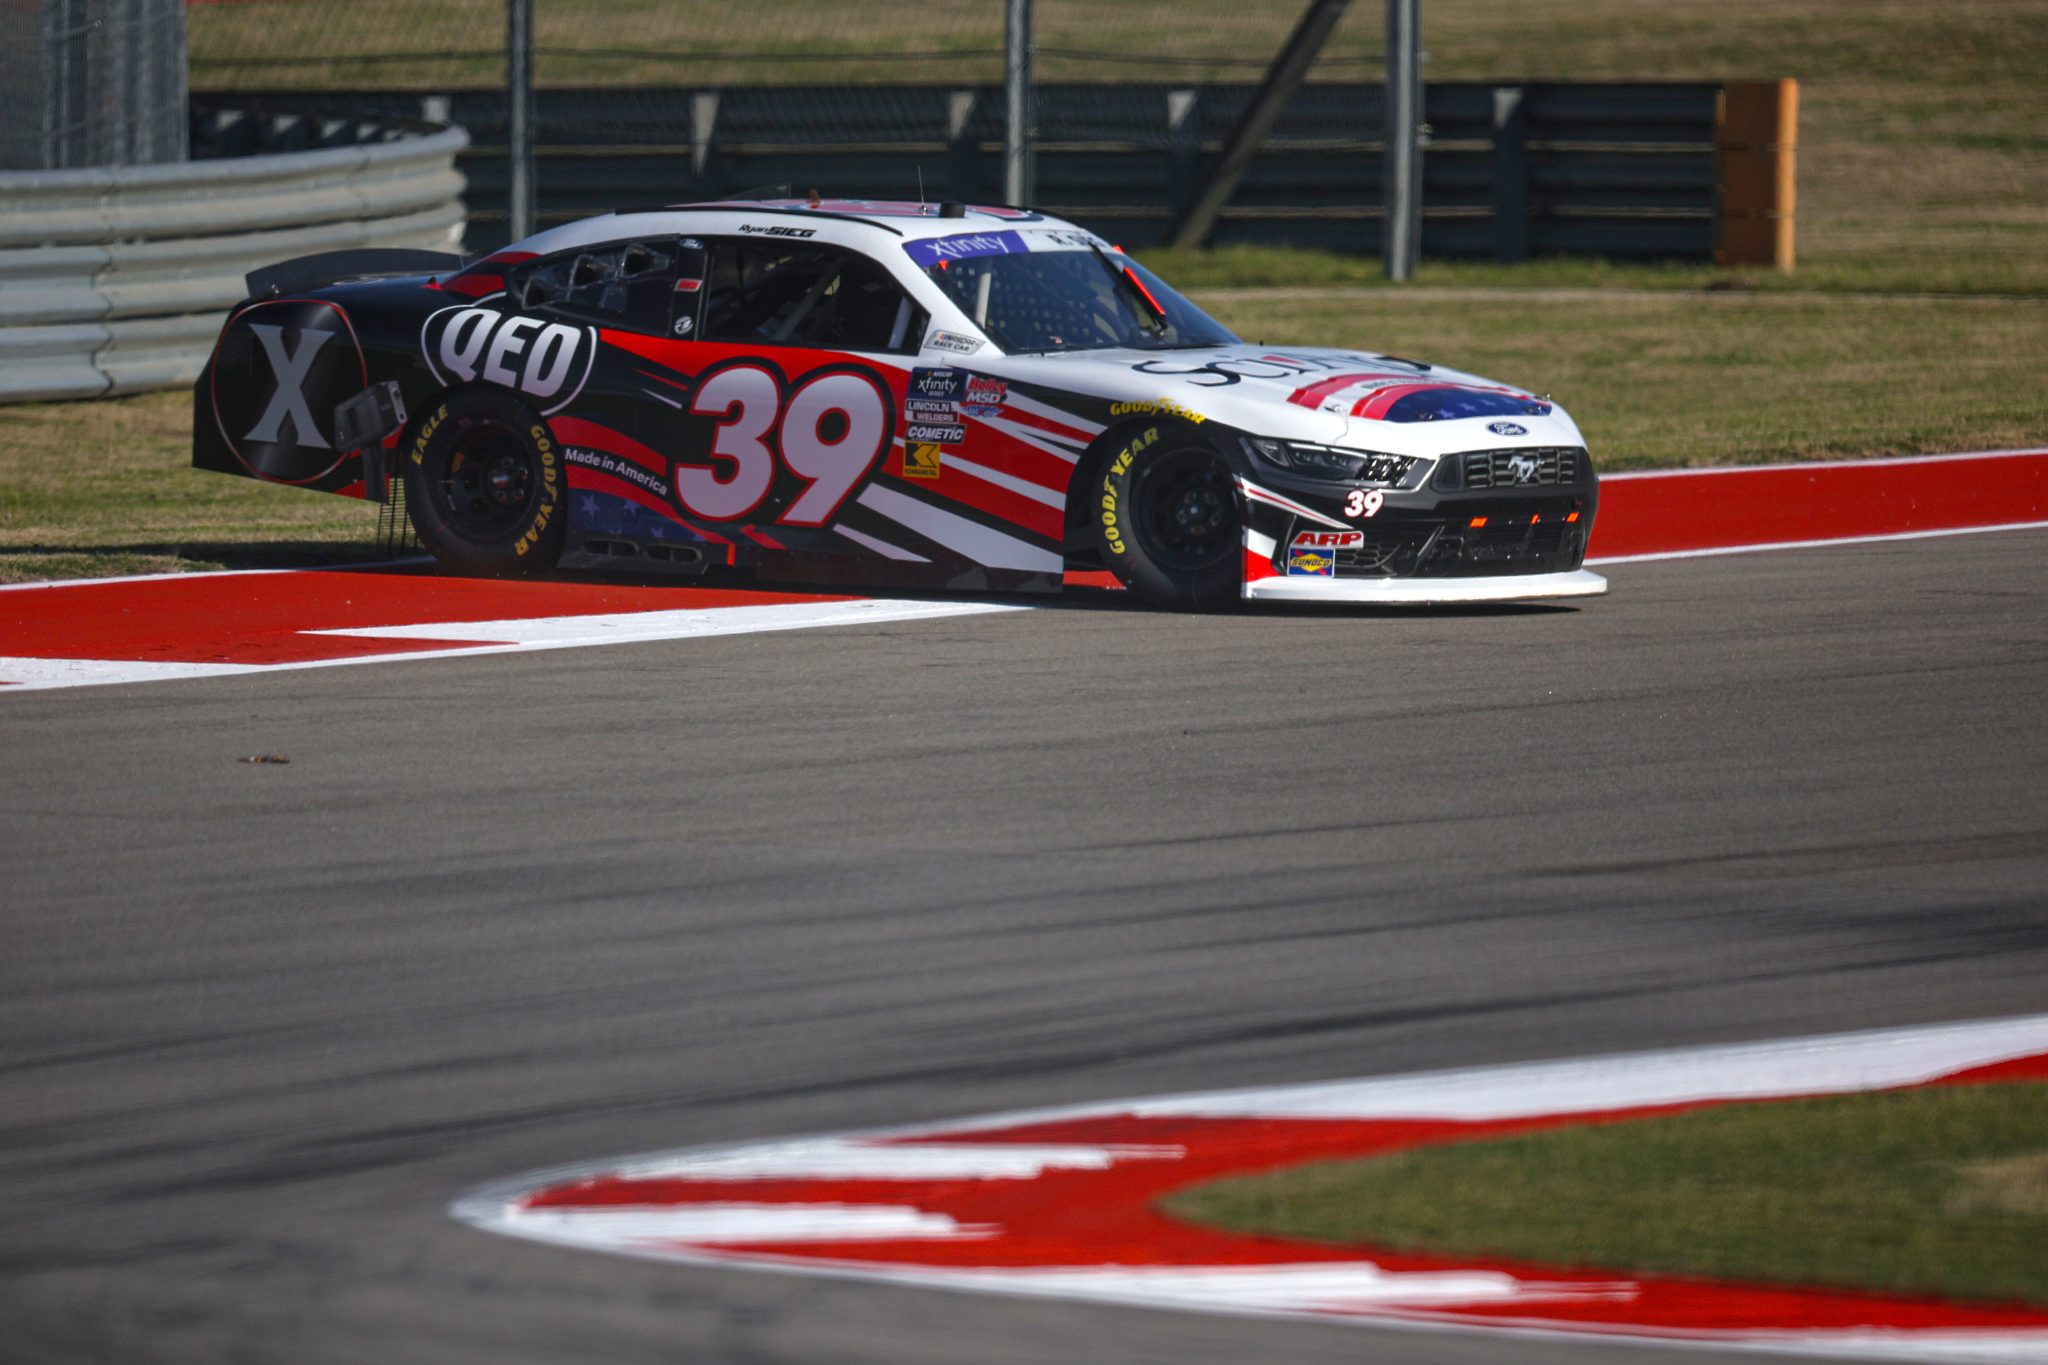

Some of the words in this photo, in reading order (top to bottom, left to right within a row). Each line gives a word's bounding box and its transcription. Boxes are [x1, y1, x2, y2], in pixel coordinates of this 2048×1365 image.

[738, 224, 768, 234] Ryan
[765, 226, 817, 238] SIEG
[925, 235, 1010, 259] xfinity
[243, 323, 335, 449] X
[918, 376, 958, 394] xfinity
[966, 391, 1002, 404] MSD
[908, 402, 950, 412] LINCOLN
[1110, 397, 1206, 424] GOODYEAR
[917, 412, 954, 422] WELDERS
[411, 404, 447, 465] EAGLE
[908, 426, 963, 440] COMETIC
[676, 365, 886, 526] 39
[565, 448, 601, 466] Made
[602, 455, 615, 470] in
[616, 461, 668, 496] America
[1344, 490, 1383, 517] 39
[1294, 532, 1362, 546] ARP
[1290, 557, 1332, 568] SUNOCO
